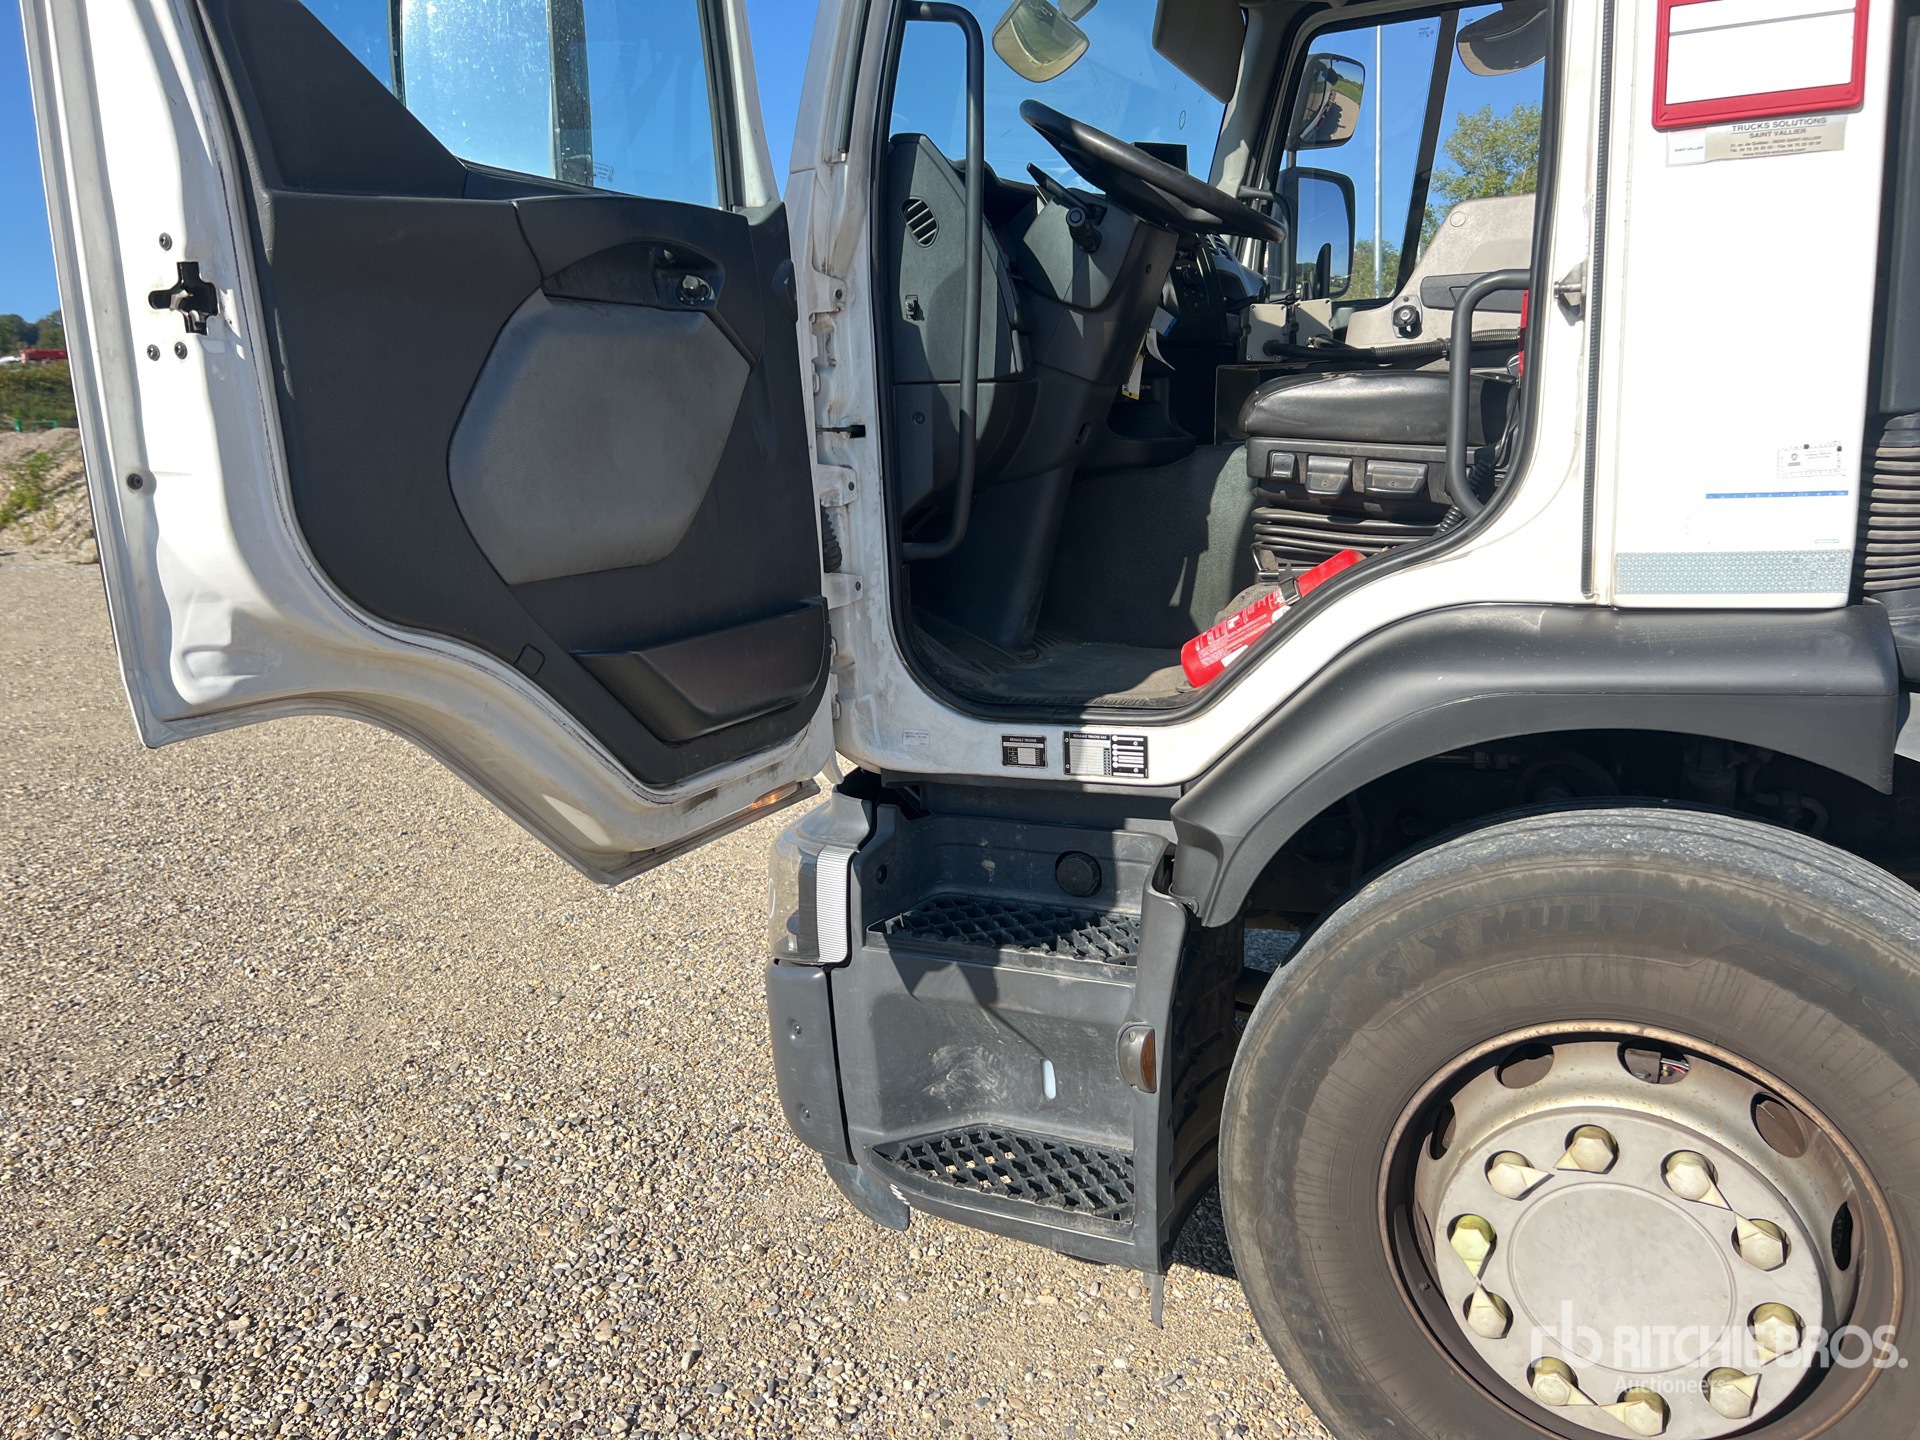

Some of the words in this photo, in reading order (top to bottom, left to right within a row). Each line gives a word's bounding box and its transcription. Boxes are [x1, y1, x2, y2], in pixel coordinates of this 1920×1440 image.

[1732, 121, 1770, 132] TRUCKS
[1772, 117, 1827, 128] SOLUTIONS
[1774, 128, 1806, 136] VALLIER
